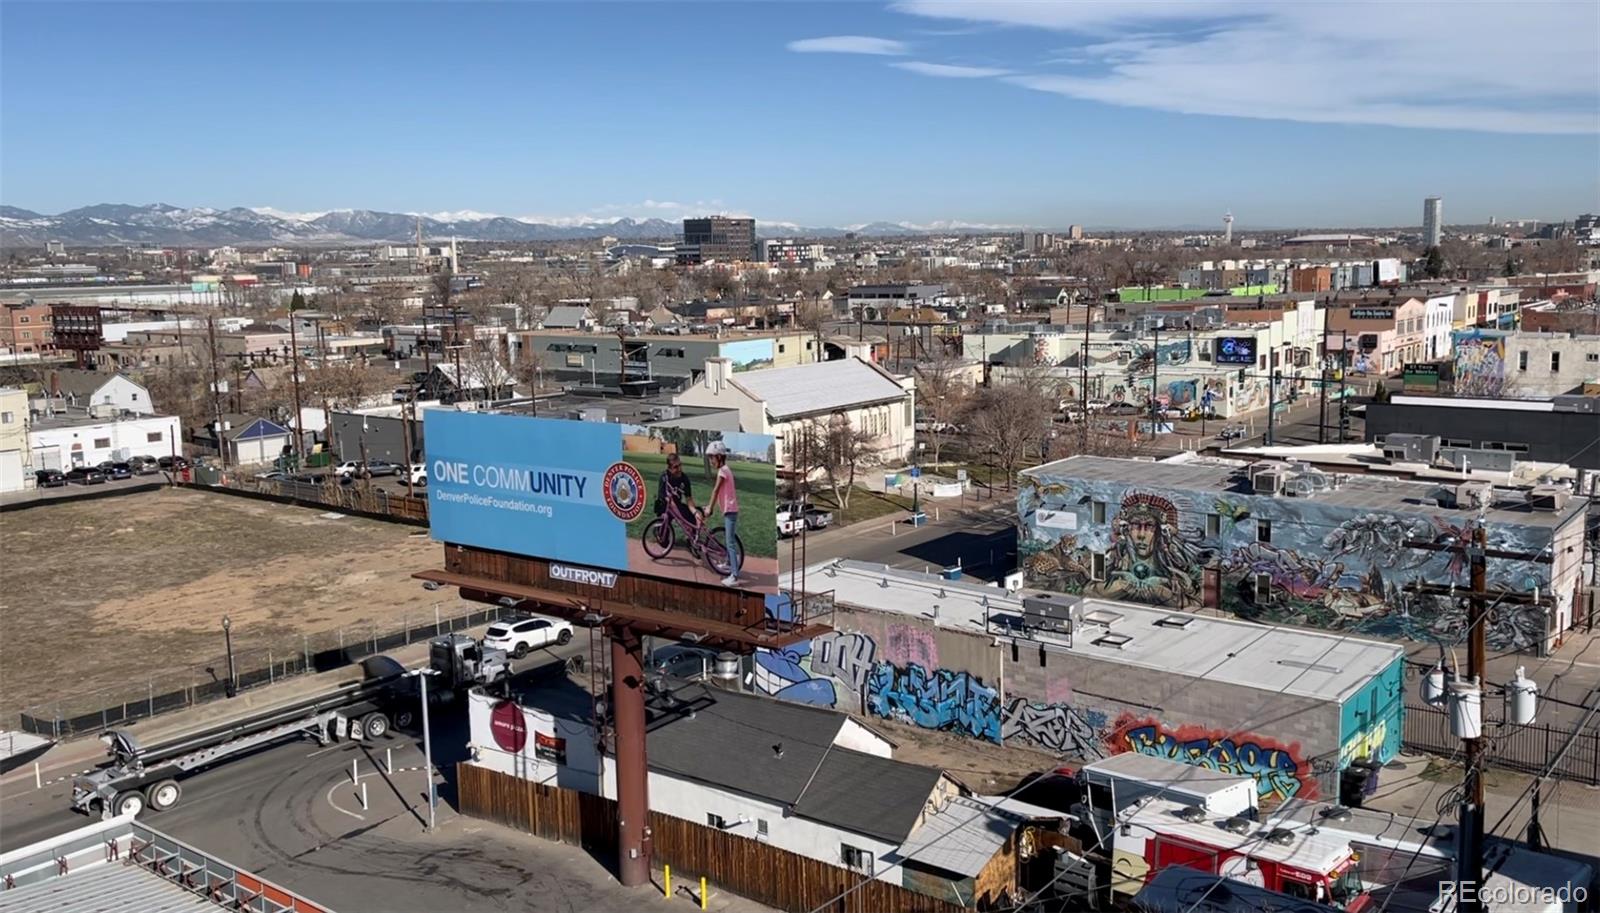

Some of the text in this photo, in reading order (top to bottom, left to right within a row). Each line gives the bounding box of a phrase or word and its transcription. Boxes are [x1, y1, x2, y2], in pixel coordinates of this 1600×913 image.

[434, 460, 587, 498] ONE COMMUNITY
[436, 490, 553, 517] DenverPoliceFoundation.org
[551, 564, 614, 585] OUTFRONT
